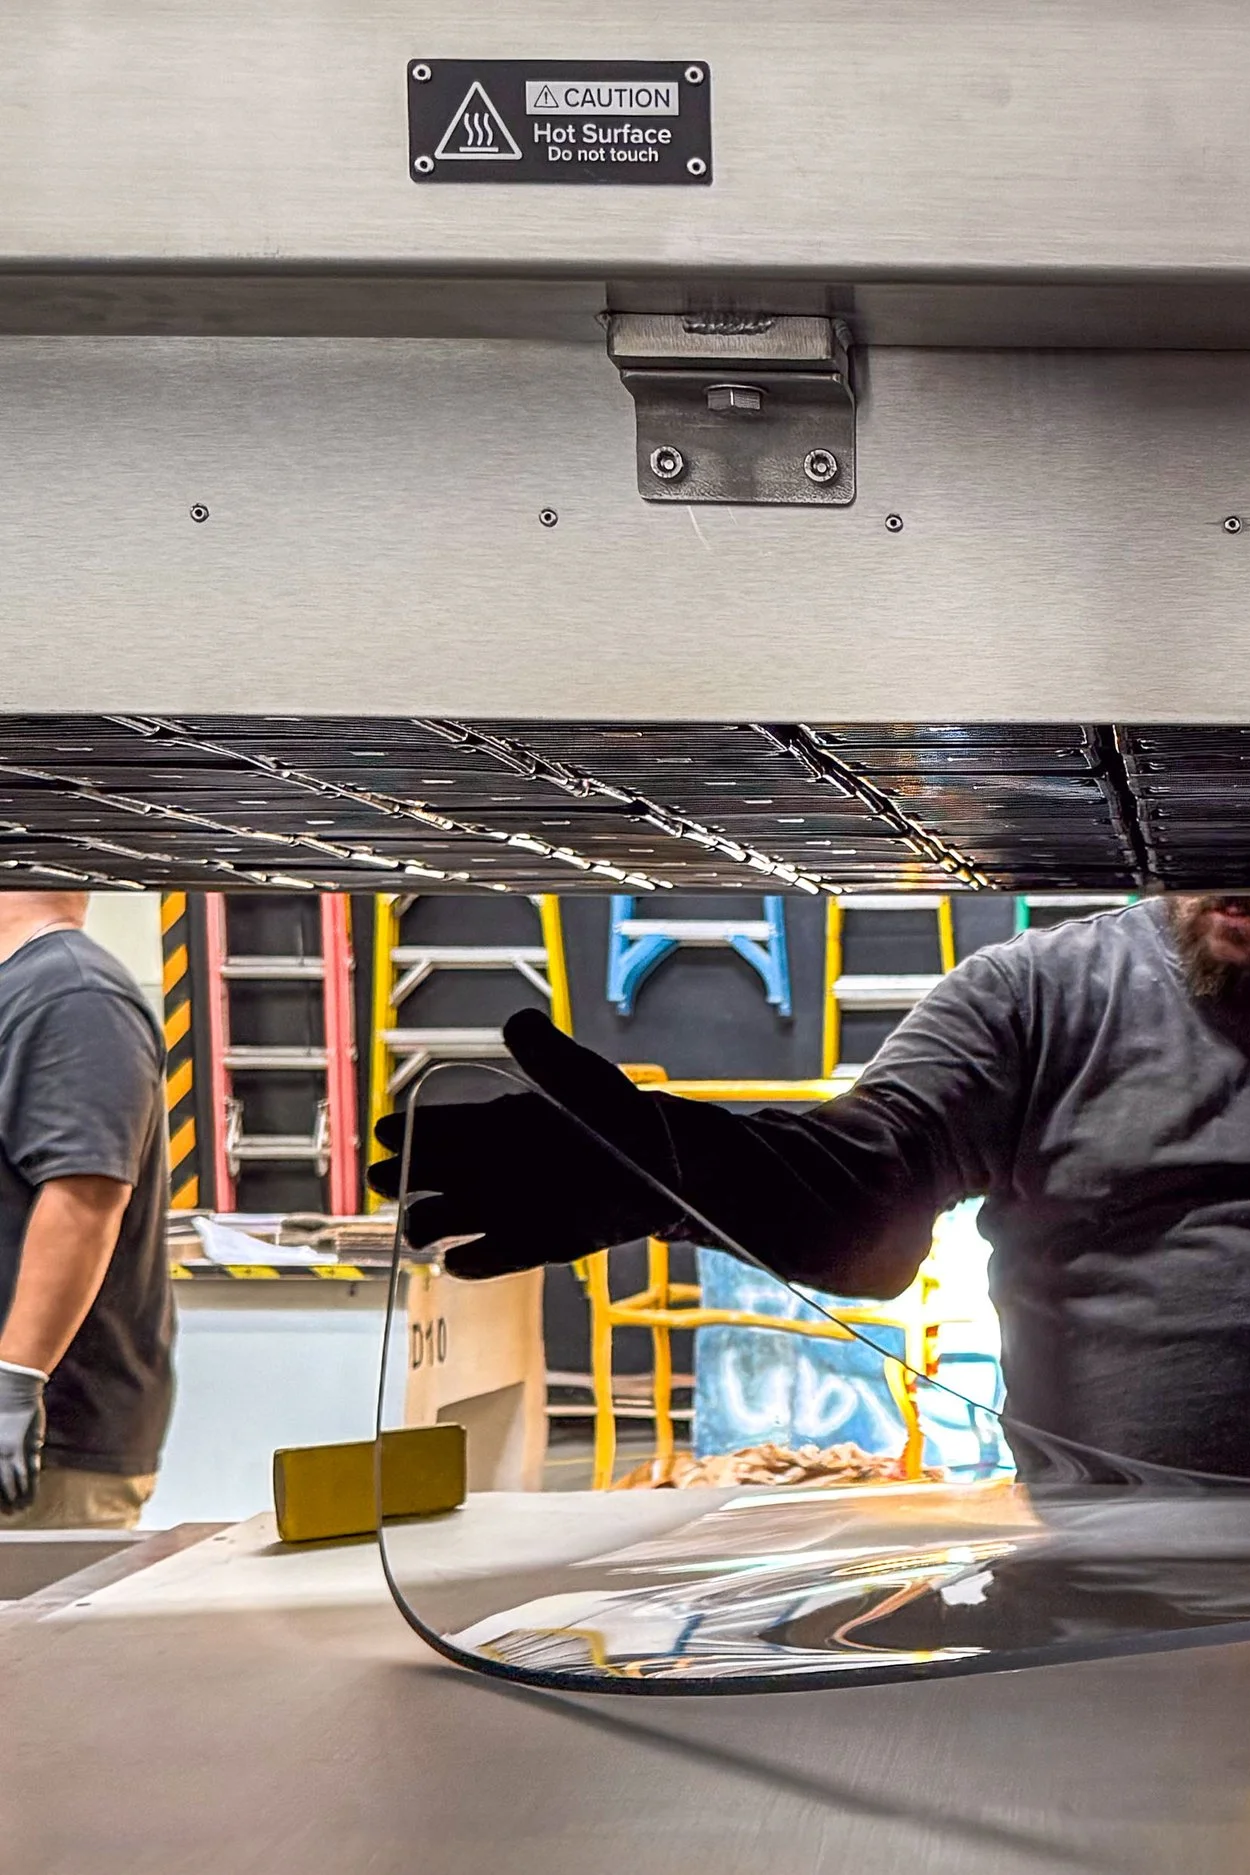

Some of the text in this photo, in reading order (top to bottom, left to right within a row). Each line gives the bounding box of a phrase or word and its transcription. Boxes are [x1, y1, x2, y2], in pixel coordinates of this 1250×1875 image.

[563, 87, 671, 108] CAUTION
[533, 122, 672, 144] Hot Surface
[547, 146, 659, 162] Do not touch
[411, 1317, 448, 1370] D10
